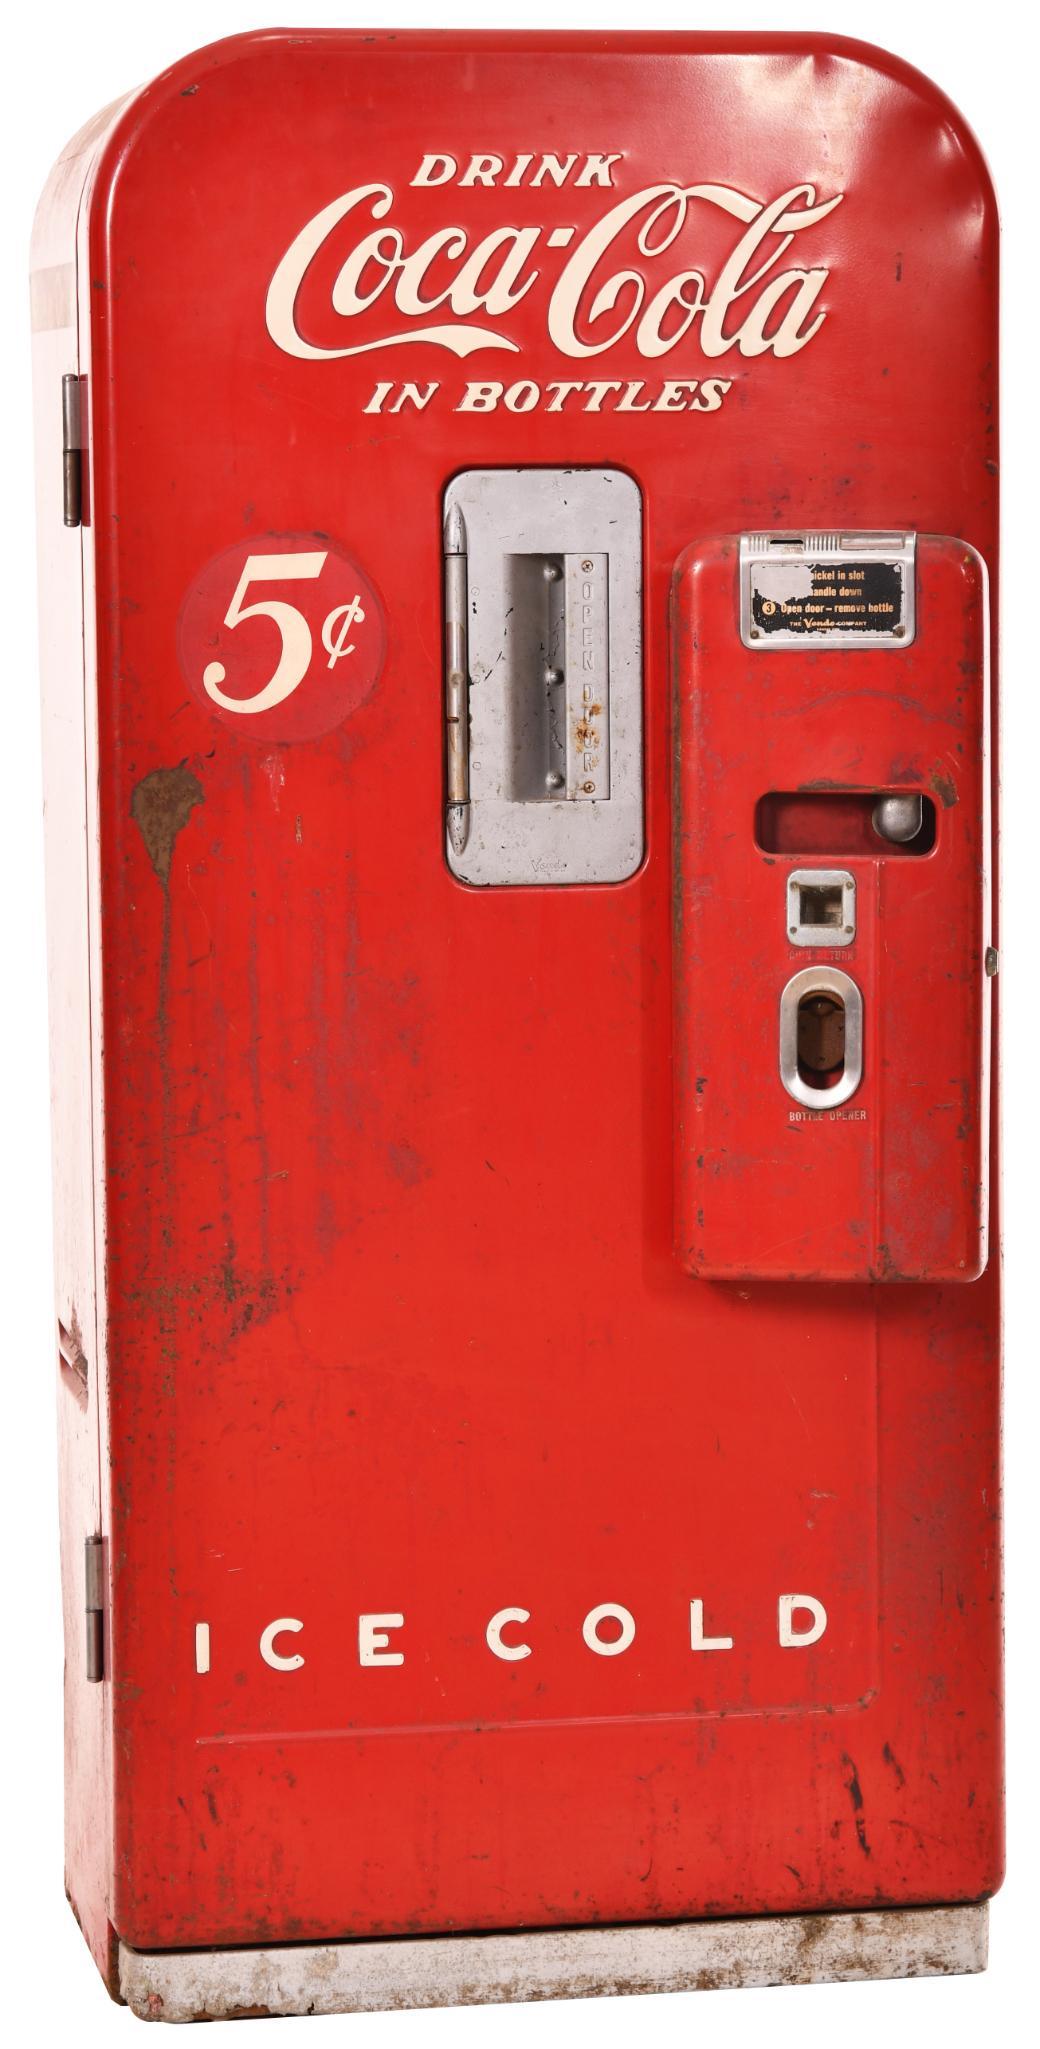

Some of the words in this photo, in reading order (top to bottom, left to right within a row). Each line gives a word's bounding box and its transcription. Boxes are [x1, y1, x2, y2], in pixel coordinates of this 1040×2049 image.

[409, 153, 624, 187] DRINK
[264, 182, 844, 359] Coca-Cola
[362, 381, 440, 414] IN
[453, 378, 733, 413] BOTTLES
[837, 570, 846, 581] in
[848, 570, 865, 581] slot
[839, 586, 862, 597] down
[780, 603, 802, 614] Open
[805, 602, 824, 613] door
[834, 603, 866, 613] remove
[868, 602, 894, 613] bottle
[803, 617, 835, 628] Vendo
[203, 551, 366, 714] 5¢
[582, 581, 594, 671] OPEN
[829, 1110, 867, 1121] OPENER
[195, 1612, 404, 1674] ICE
[485, 1594, 828, 1662] COLD
